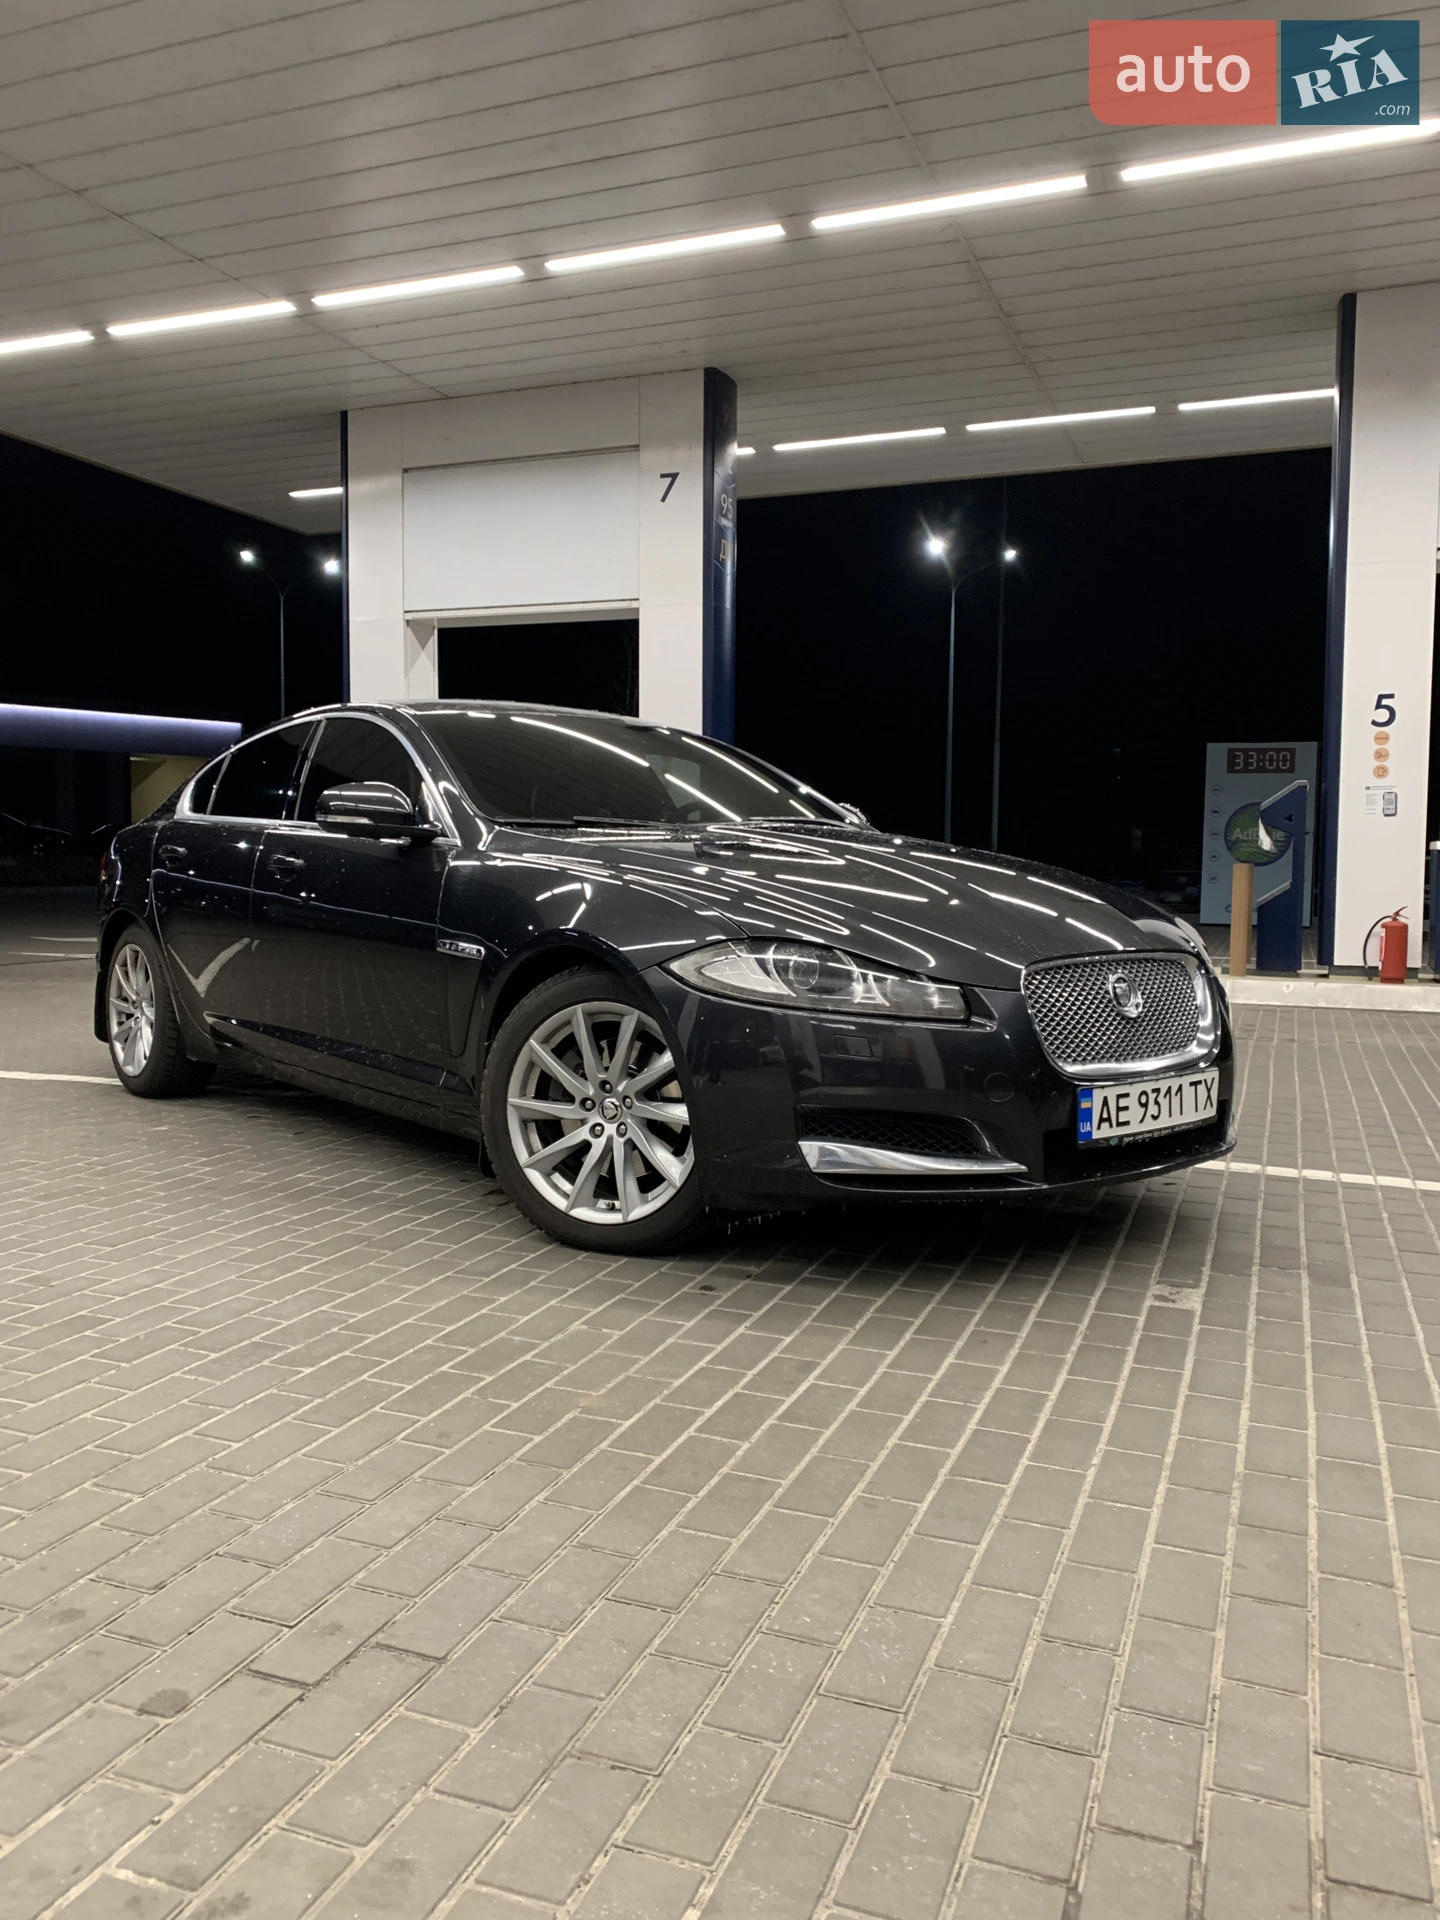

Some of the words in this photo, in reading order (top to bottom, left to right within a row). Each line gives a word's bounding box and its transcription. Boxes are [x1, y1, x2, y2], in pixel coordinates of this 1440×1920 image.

[660, 472, 680, 503] 7
[720, 493, 733, 519] 95
[1371, 693, 1397, 728] 5
[1233, 751, 1291, 770] 33:00
[1096, 1092, 1131, 1131] AE
[1137, 1083, 1183, 1124] 9311
[1189, 1077, 1215, 1111] TX
[1080, 1121, 1092, 1133] UA
